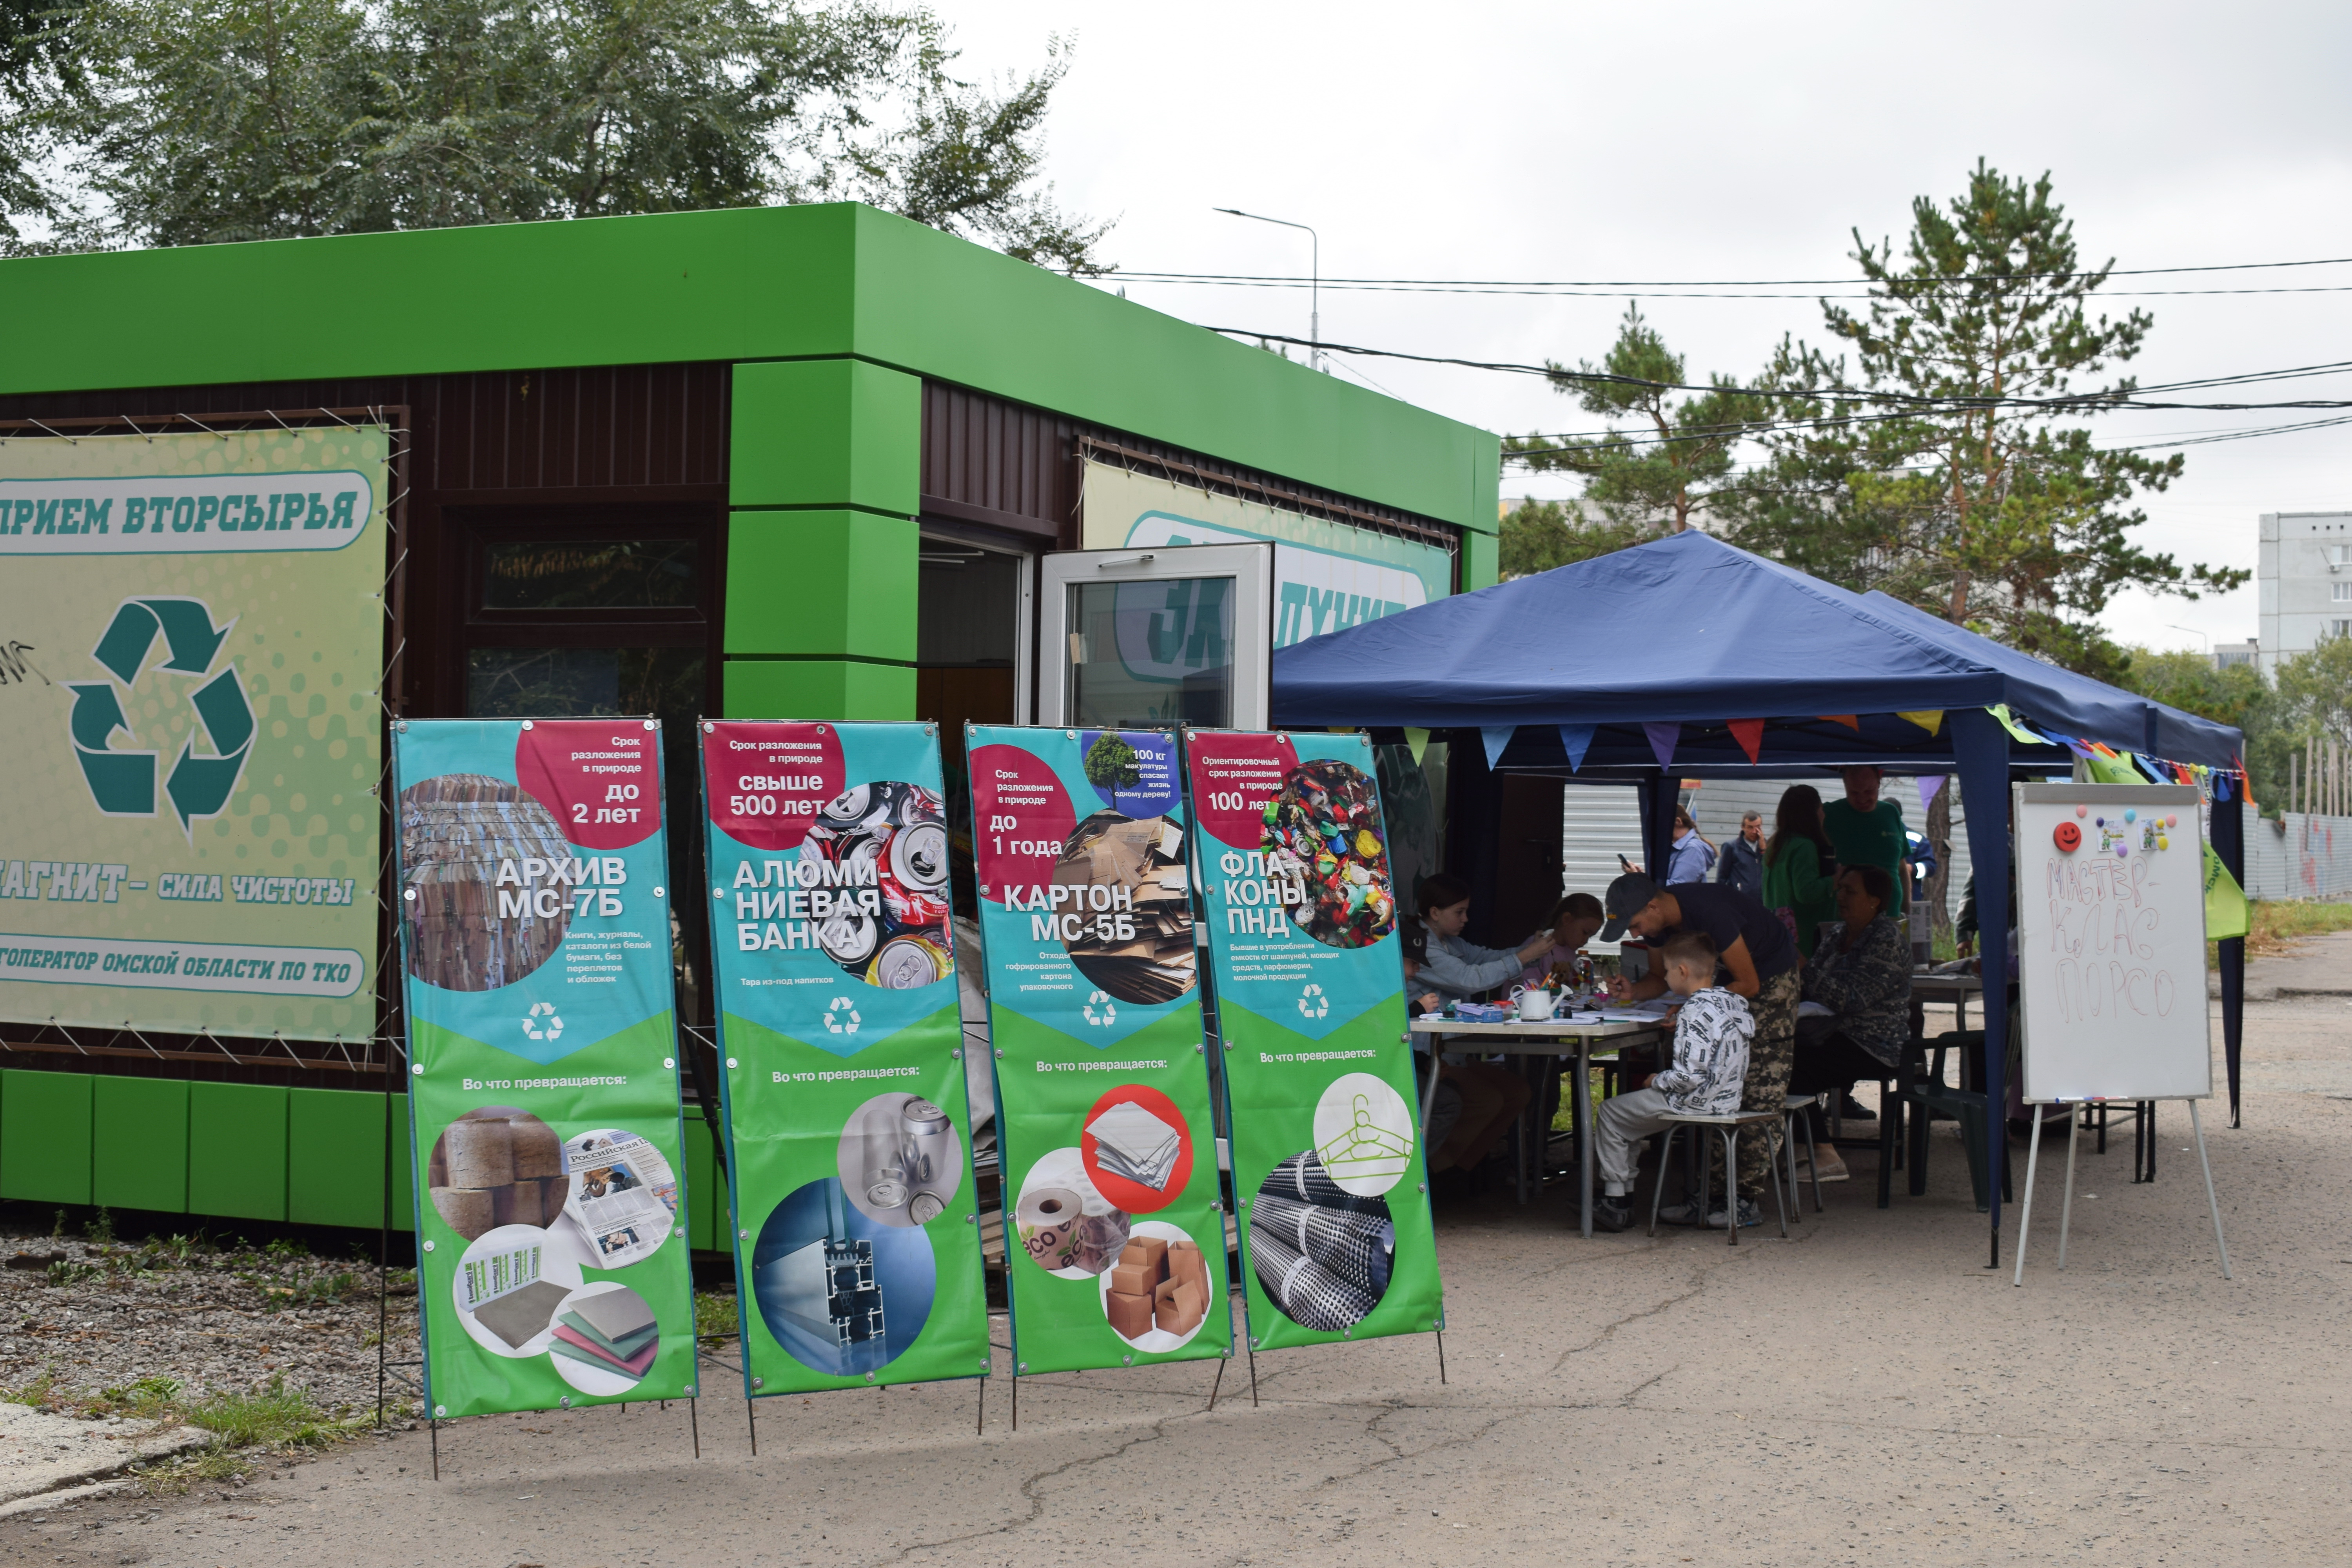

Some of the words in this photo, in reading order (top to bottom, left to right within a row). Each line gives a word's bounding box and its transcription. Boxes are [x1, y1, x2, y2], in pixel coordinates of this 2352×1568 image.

[121, 491, 358, 534] ВТОРСЫРЬЯ
[612, 737, 640, 747] Срок
[730, 740, 756, 751] Срок
[759, 741, 822, 751] разложения
[572, 750, 641, 760] разложения
[778, 756, 822, 764] природе
[1132, 749, 1153, 760] 100
[1203, 757, 1279, 766] Ориентировочный
[592, 765, 641, 774] природе
[995, 769, 1018, 779] Срок
[739, 776, 823, 790] свыше
[997, 783, 1053, 792] разложения
[1246, 782, 1283, 791] природе
[605, 784, 639, 802] до
[1209, 792, 1243, 810] 100
[1249, 800, 1270, 810] лет
[572, 804, 588, 823] 2
[595, 808, 641, 823] лет
[731, 795, 776, 815] 500
[782, 800, 825, 815] лет
[990, 815, 1016, 832] до
[993, 836, 1001, 854] 1
[1011, 840, 1062, 857] года
[495, 857, 627, 887] АРХИВ
[1220, 850, 1295, 878] ФЛА-
[0, 860, 127, 904] АГНИТ
[157, 873, 223, 903] СИЛА
[231, 875, 354, 906] ЧИСТОТЫ
[733, 859, 891, 889] АЛЮМИ-
[1004, 884, 1132, 912] КАРТОН
[1224, 879, 1307, 905] КОНЫ
[499, 889, 623, 918] МС-7Б
[736, 889, 881, 920] НИЕВАЯ
[1031, 915, 1135, 941] МС-5Б
[1227, 908, 1290, 938] ПНД
[2049, 899, 2159, 960] КЛАС
[738, 921, 861, 951] БАНКА
[1265, 943, 1314, 951] употреблении
[102, 951, 178, 976] ОМСКОЙ
[182, 957, 274, 980] ОБЛАСТИ
[279, 963, 305, 982] ПО
[312, 963, 351, 983] ТКО
[566, 954, 603, 962] бумаги,
[740, 978, 760, 987] Тара
[1260, 1053, 1273, 1062] Во
[1296, 1050, 1376, 1063] превращается:
[773, 1072, 789, 1082] Во
[793, 1073, 815, 1081] что
[818, 1067, 919, 1082] превращается:
[1037, 1061, 1052, 1071] Во
[1078, 1060, 1167, 1073] превращается:
[463, 1079, 482, 1090] Во
[486, 1078, 510, 1089] что
[515, 1075, 626, 1090] превращается:
[570, 1143, 639, 1162] Российская
